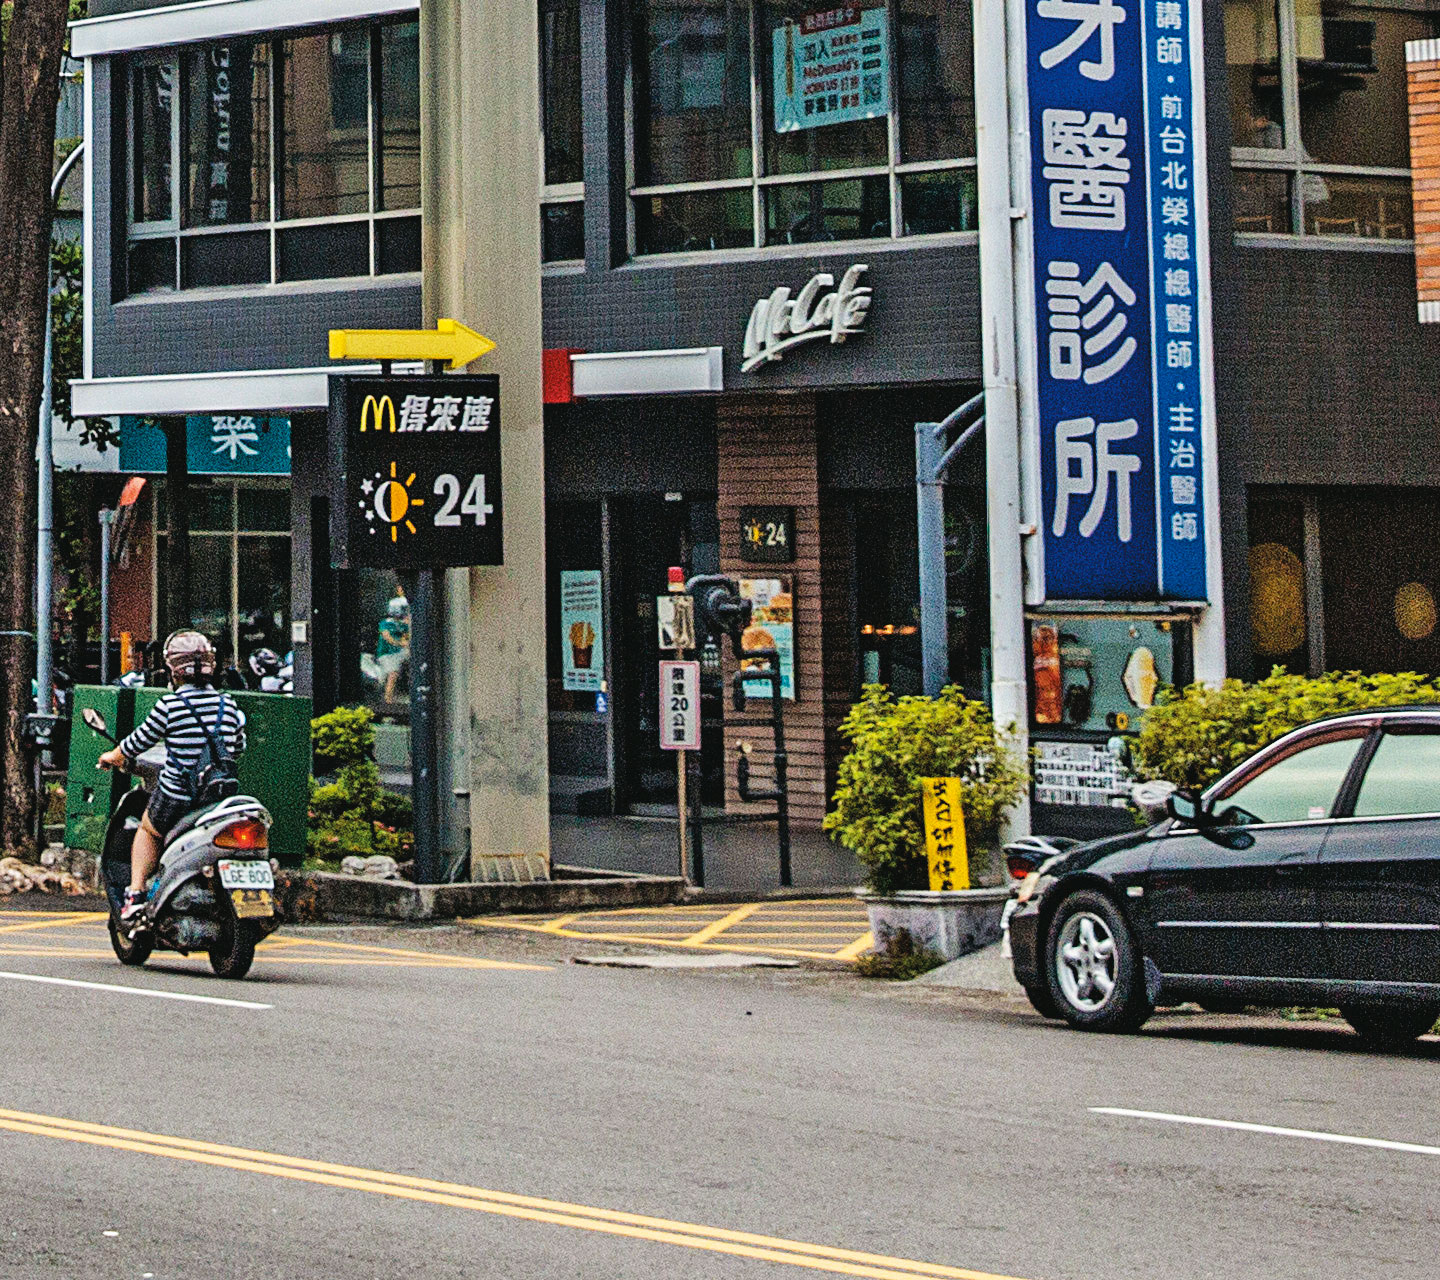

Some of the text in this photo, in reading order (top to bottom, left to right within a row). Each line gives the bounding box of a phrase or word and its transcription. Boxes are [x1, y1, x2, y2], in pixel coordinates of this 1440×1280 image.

[396, 393, 495, 434] 得來速
[432, 472, 495, 528] 24
[765, 522, 788, 546] 24
